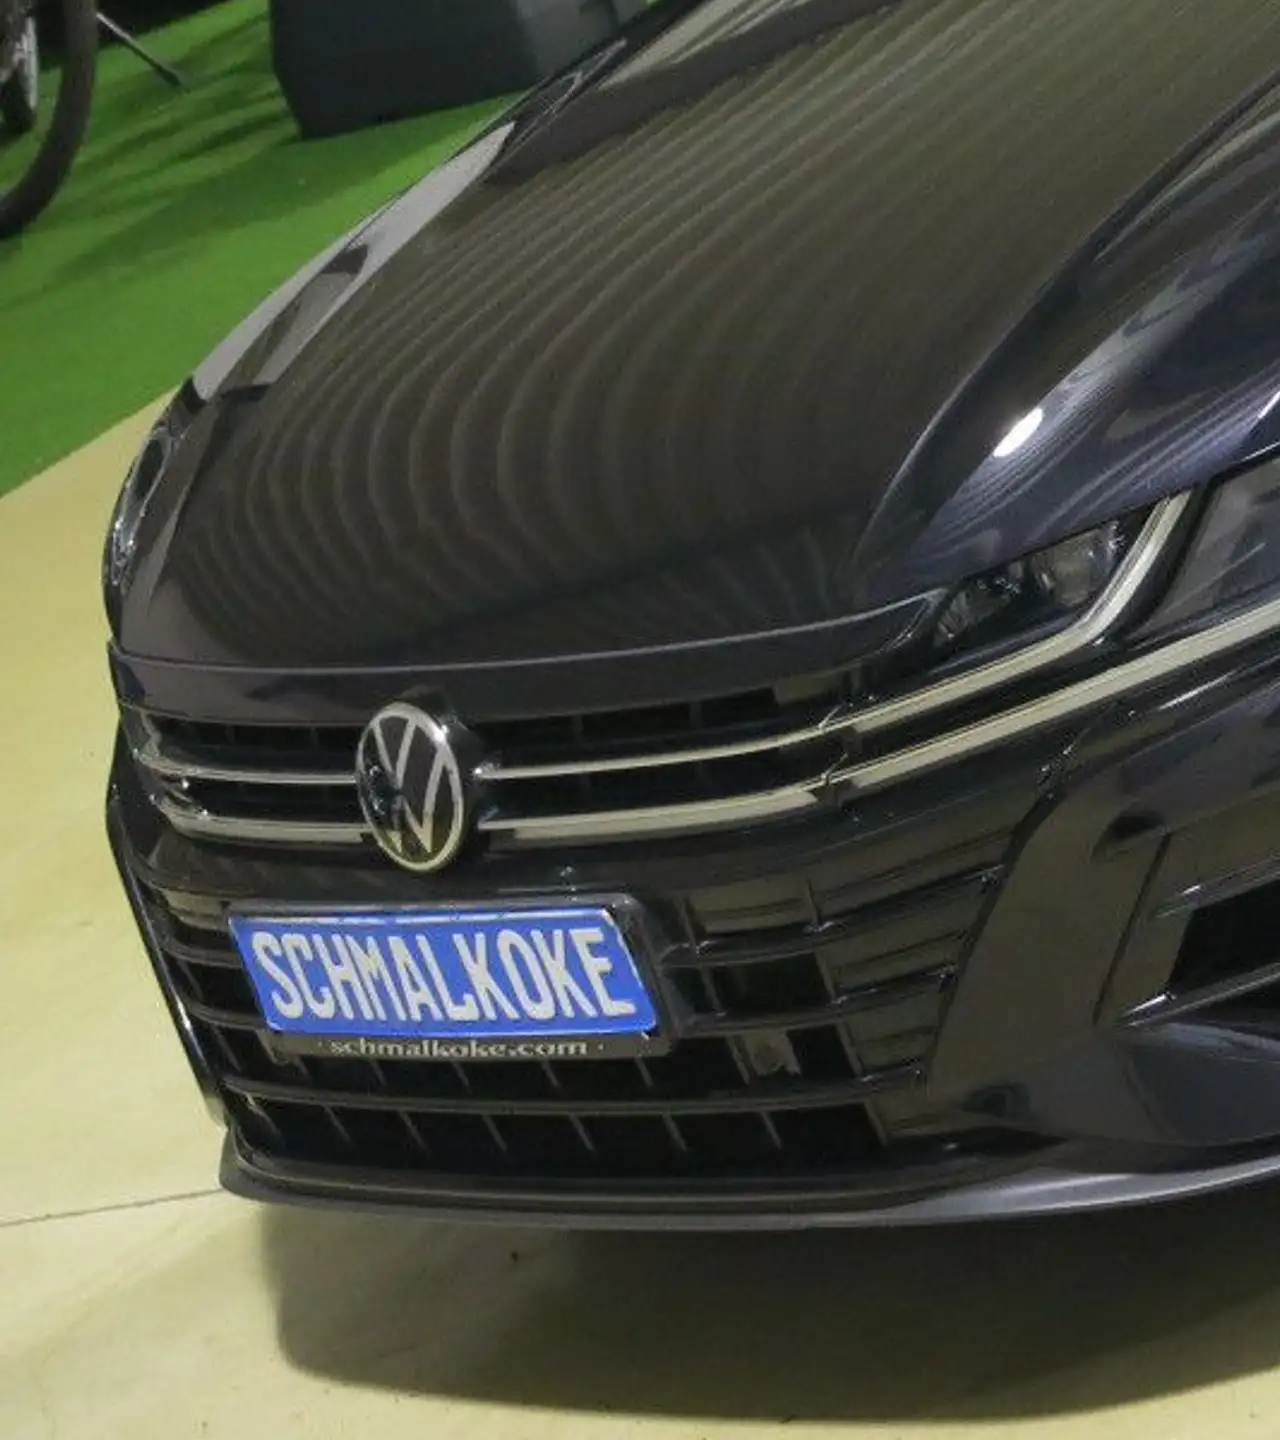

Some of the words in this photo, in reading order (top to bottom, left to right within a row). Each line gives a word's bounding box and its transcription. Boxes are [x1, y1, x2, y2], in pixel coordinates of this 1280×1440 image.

[356, 701, 463, 871] VW
[251, 926, 637, 1022] SCHMALKOKE
[330, 1036, 588, 1059] schmalkoke.com
